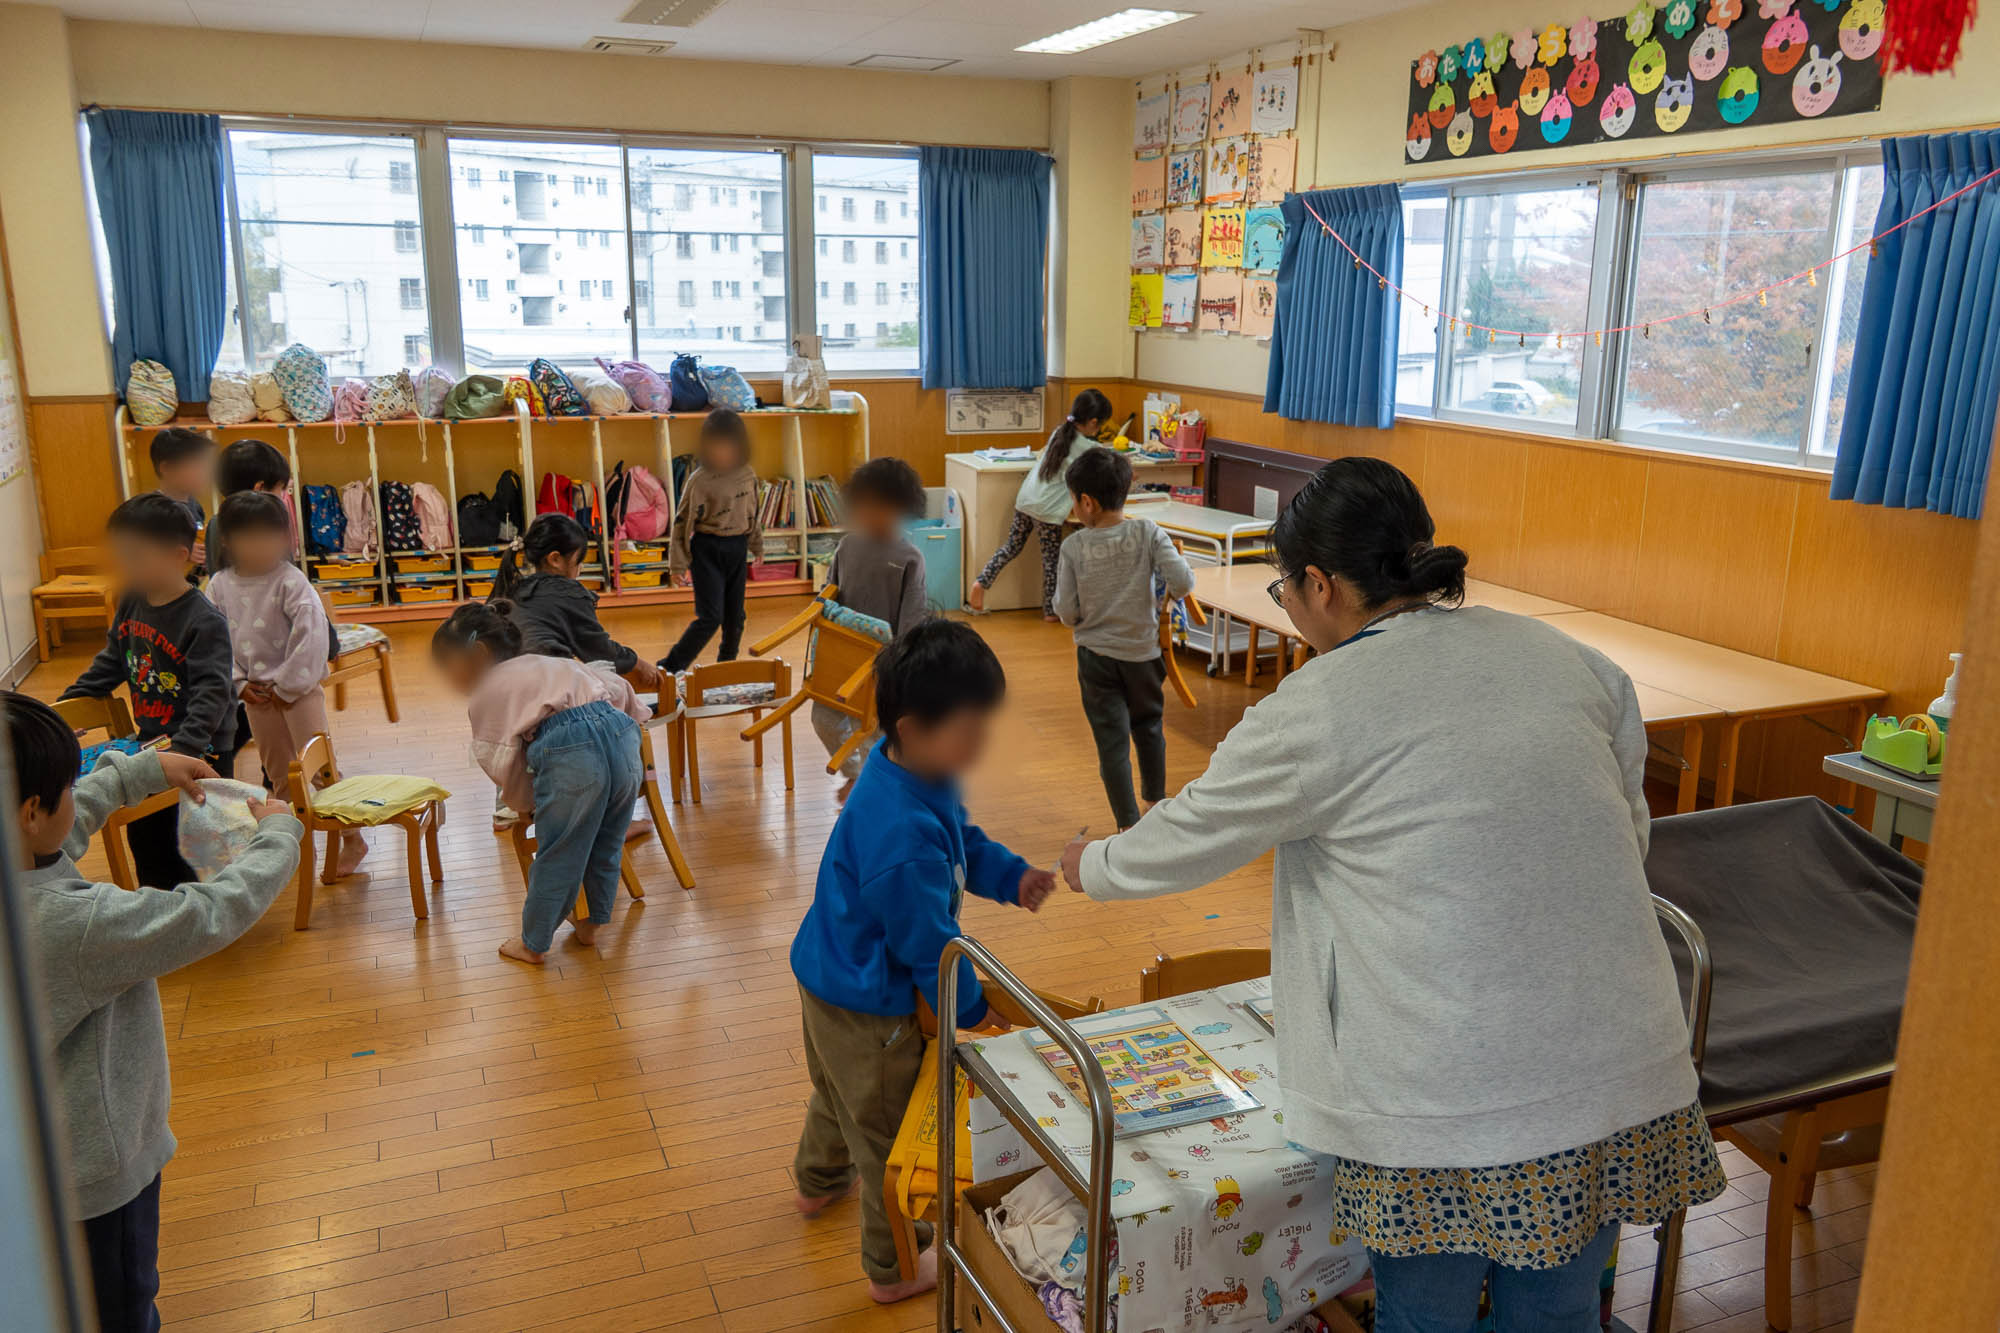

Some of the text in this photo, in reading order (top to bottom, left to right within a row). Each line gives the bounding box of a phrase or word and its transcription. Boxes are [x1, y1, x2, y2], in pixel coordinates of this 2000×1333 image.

[1256, 1063, 1277, 1080] POOH
[1213, 1133, 1251, 1145] TIGGER
[1211, 1222, 1240, 1237] POOH
[1278, 1221, 1312, 1237] PIGLET
[1136, 1261, 1146, 1294] POOH
[1184, 1287, 1193, 1328] TIGGER
